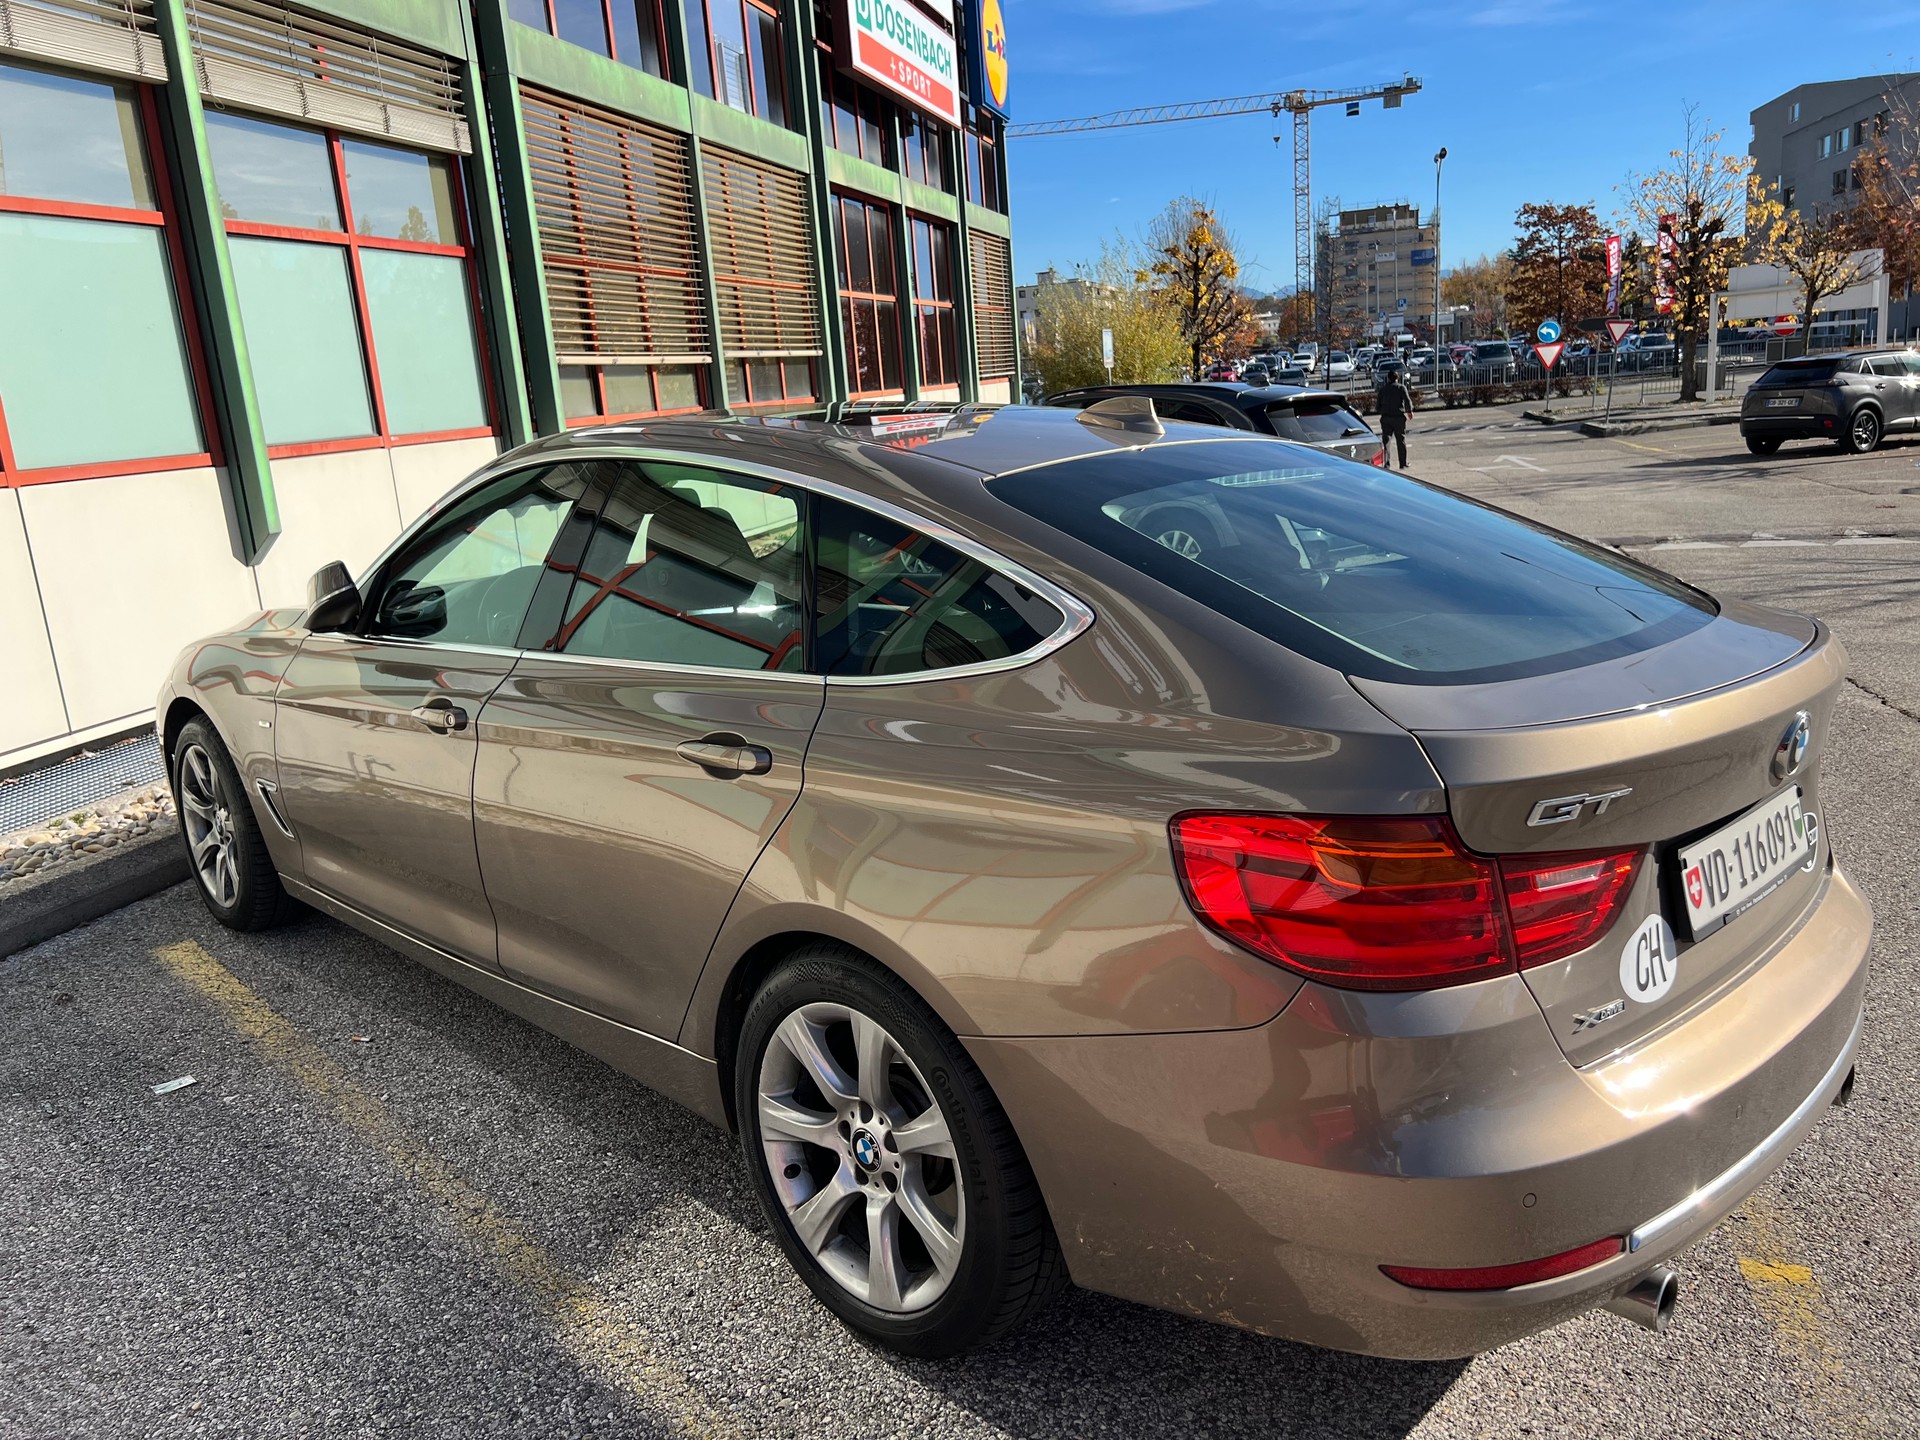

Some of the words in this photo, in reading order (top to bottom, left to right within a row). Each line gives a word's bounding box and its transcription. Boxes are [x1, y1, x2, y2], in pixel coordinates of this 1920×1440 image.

[875, 0, 952, 79] DOSENBACH
[1527, 788, 1632, 826] GT
[1636, 922, 1667, 992] CH
